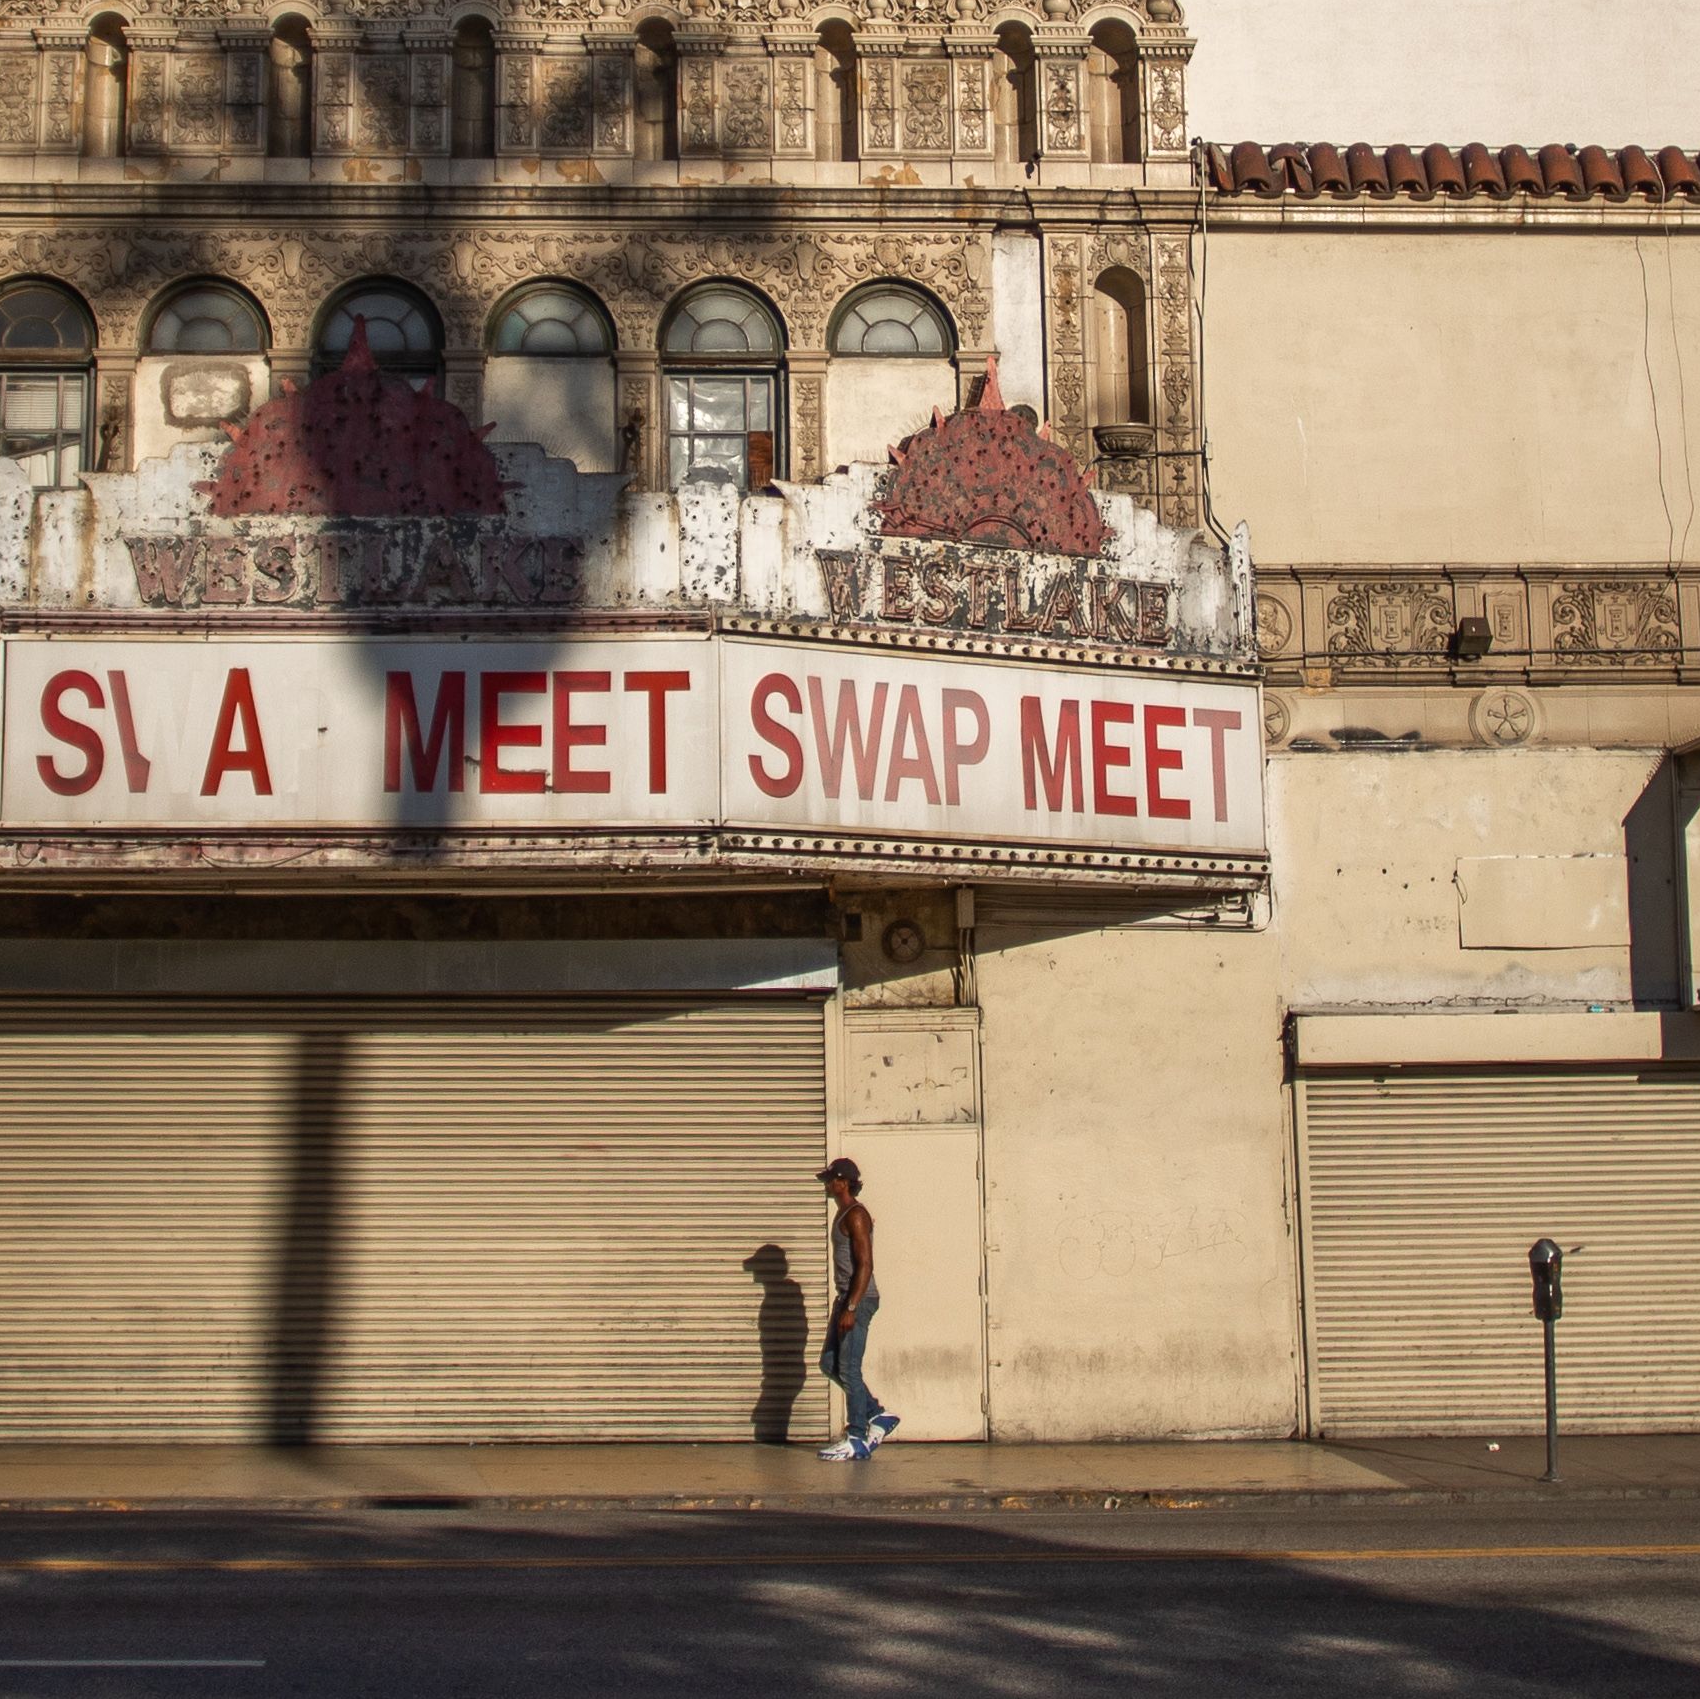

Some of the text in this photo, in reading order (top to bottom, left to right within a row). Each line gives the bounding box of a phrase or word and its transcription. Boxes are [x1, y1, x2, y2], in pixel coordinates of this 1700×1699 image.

[123, 534, 587, 604] WESTLAKE
[815, 548, 1173, 646] WESTLAKE
[383, 669, 691, 795] MEET
[747, 671, 1243, 824] SWAP MEET
